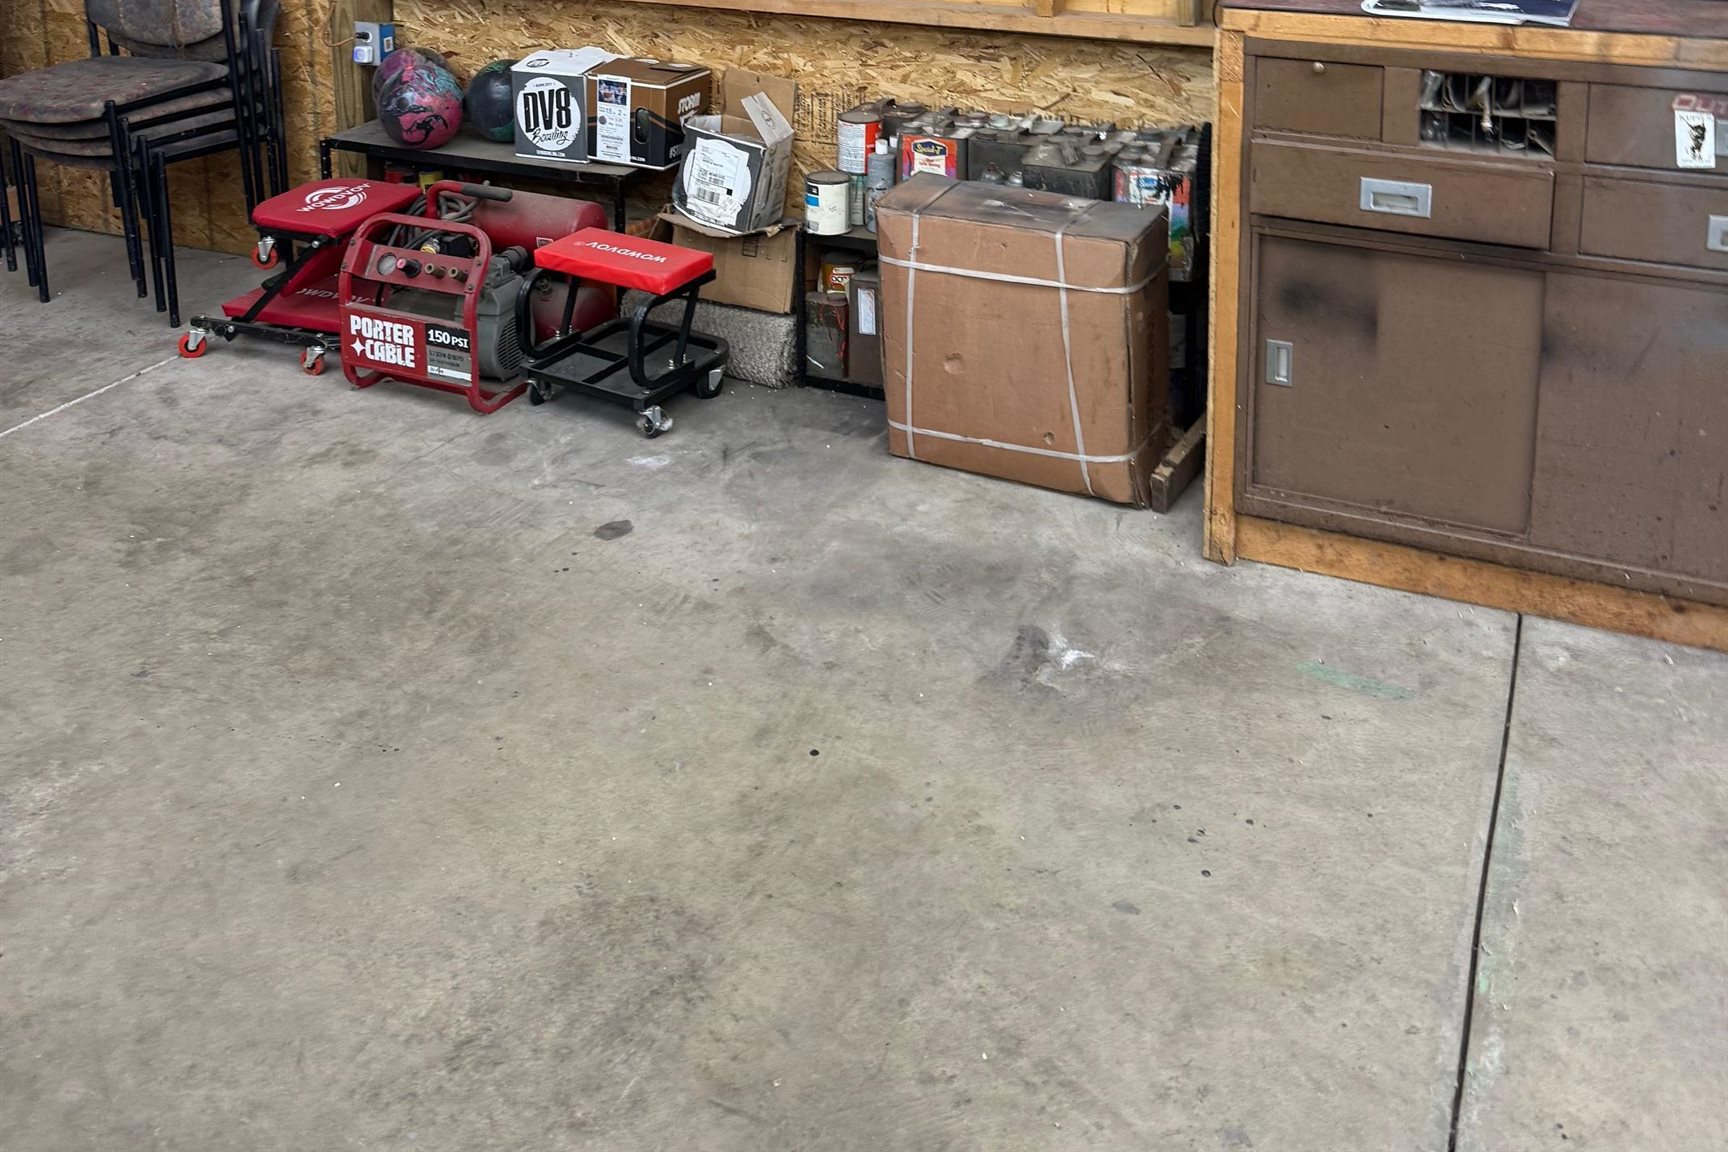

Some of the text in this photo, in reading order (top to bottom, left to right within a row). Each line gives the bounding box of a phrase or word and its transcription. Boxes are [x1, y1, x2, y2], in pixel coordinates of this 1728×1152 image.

[523, 87, 572, 133] DV8
[532, 127, 570, 146] Bowling
[296, 183, 371, 212] WOWDVOV
[585, 241, 668, 263] WOWDVOV
[350, 315, 414, 346] PORTER
[427, 329, 469, 349] 150 PSI
[364, 340, 416, 368] CABLE
